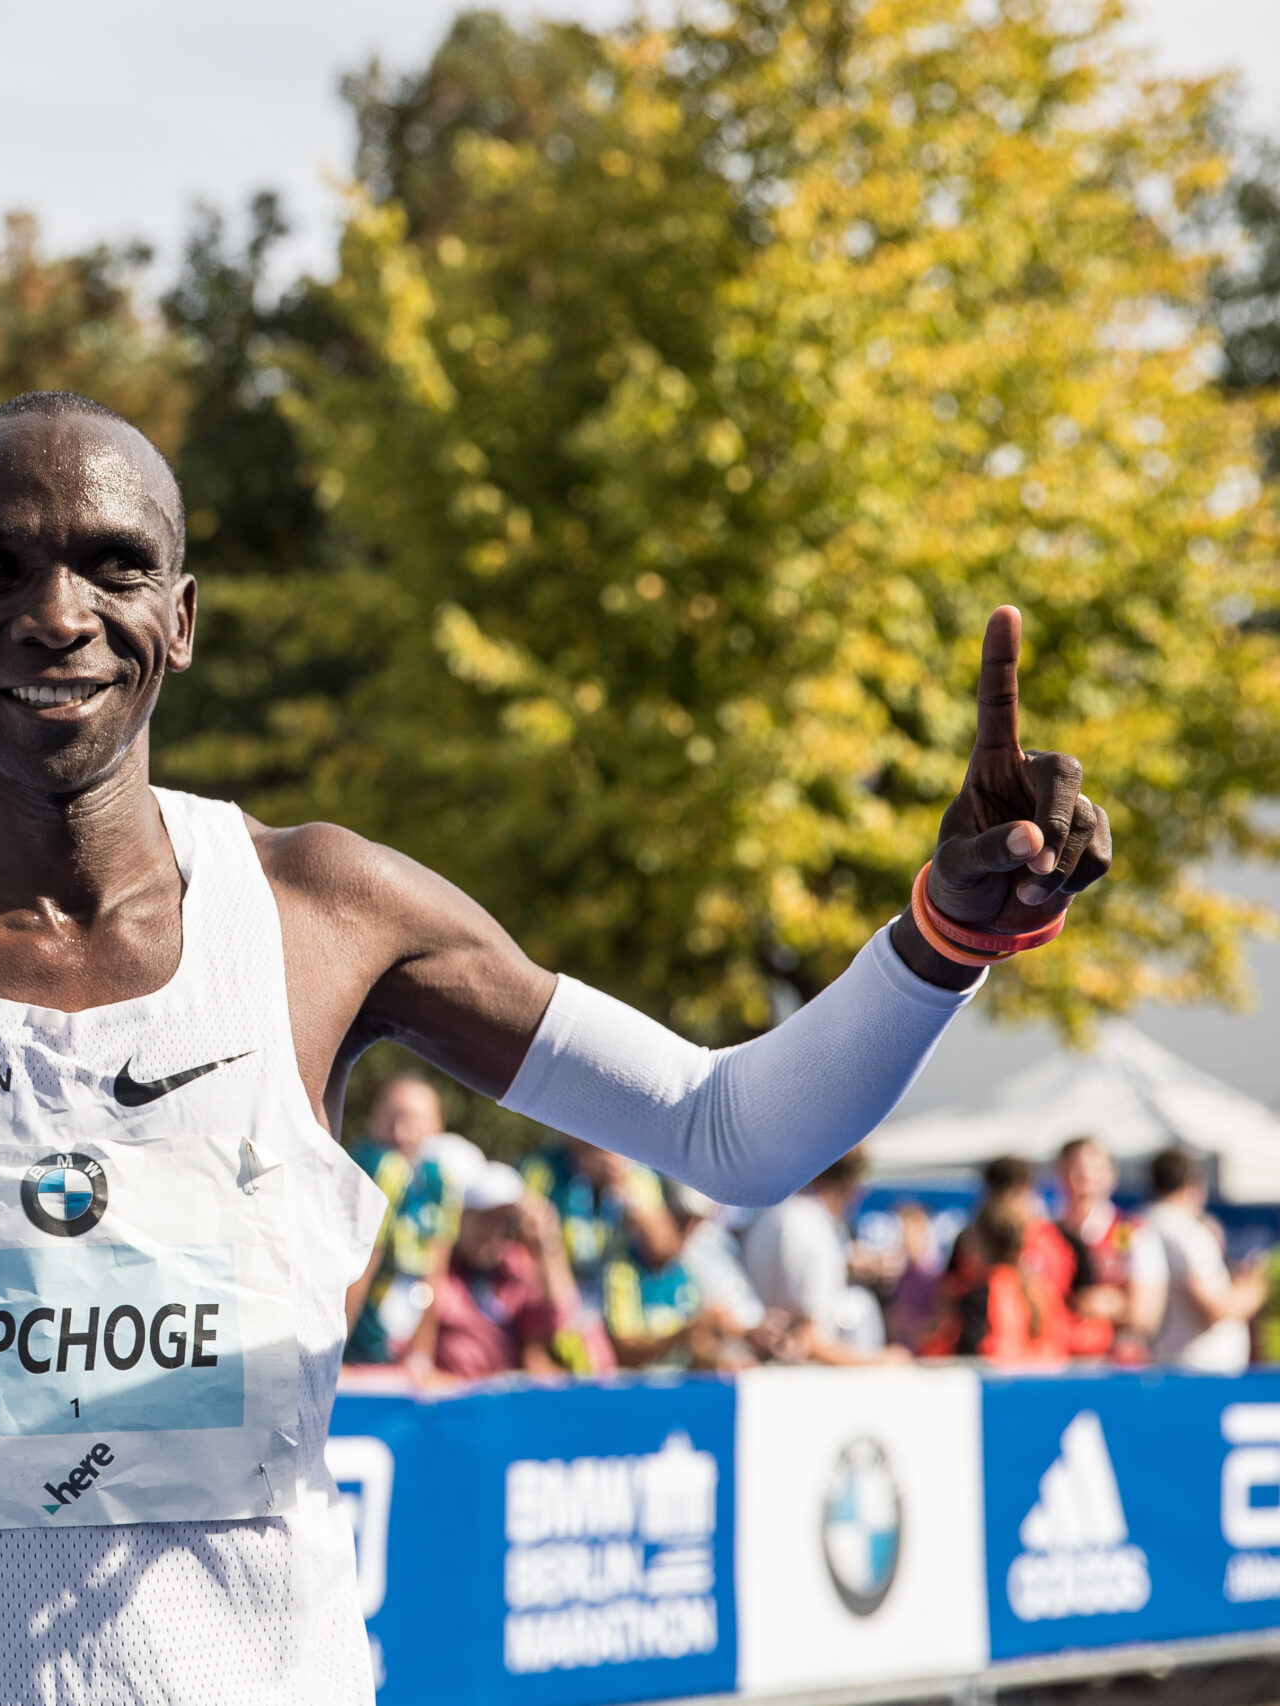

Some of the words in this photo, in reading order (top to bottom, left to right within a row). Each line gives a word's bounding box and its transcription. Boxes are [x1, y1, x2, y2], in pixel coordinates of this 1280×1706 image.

[28, 1154, 102, 1180] BMW
[70, 1398, 80, 1418] 1
[43, 1443, 115, 1504] here
